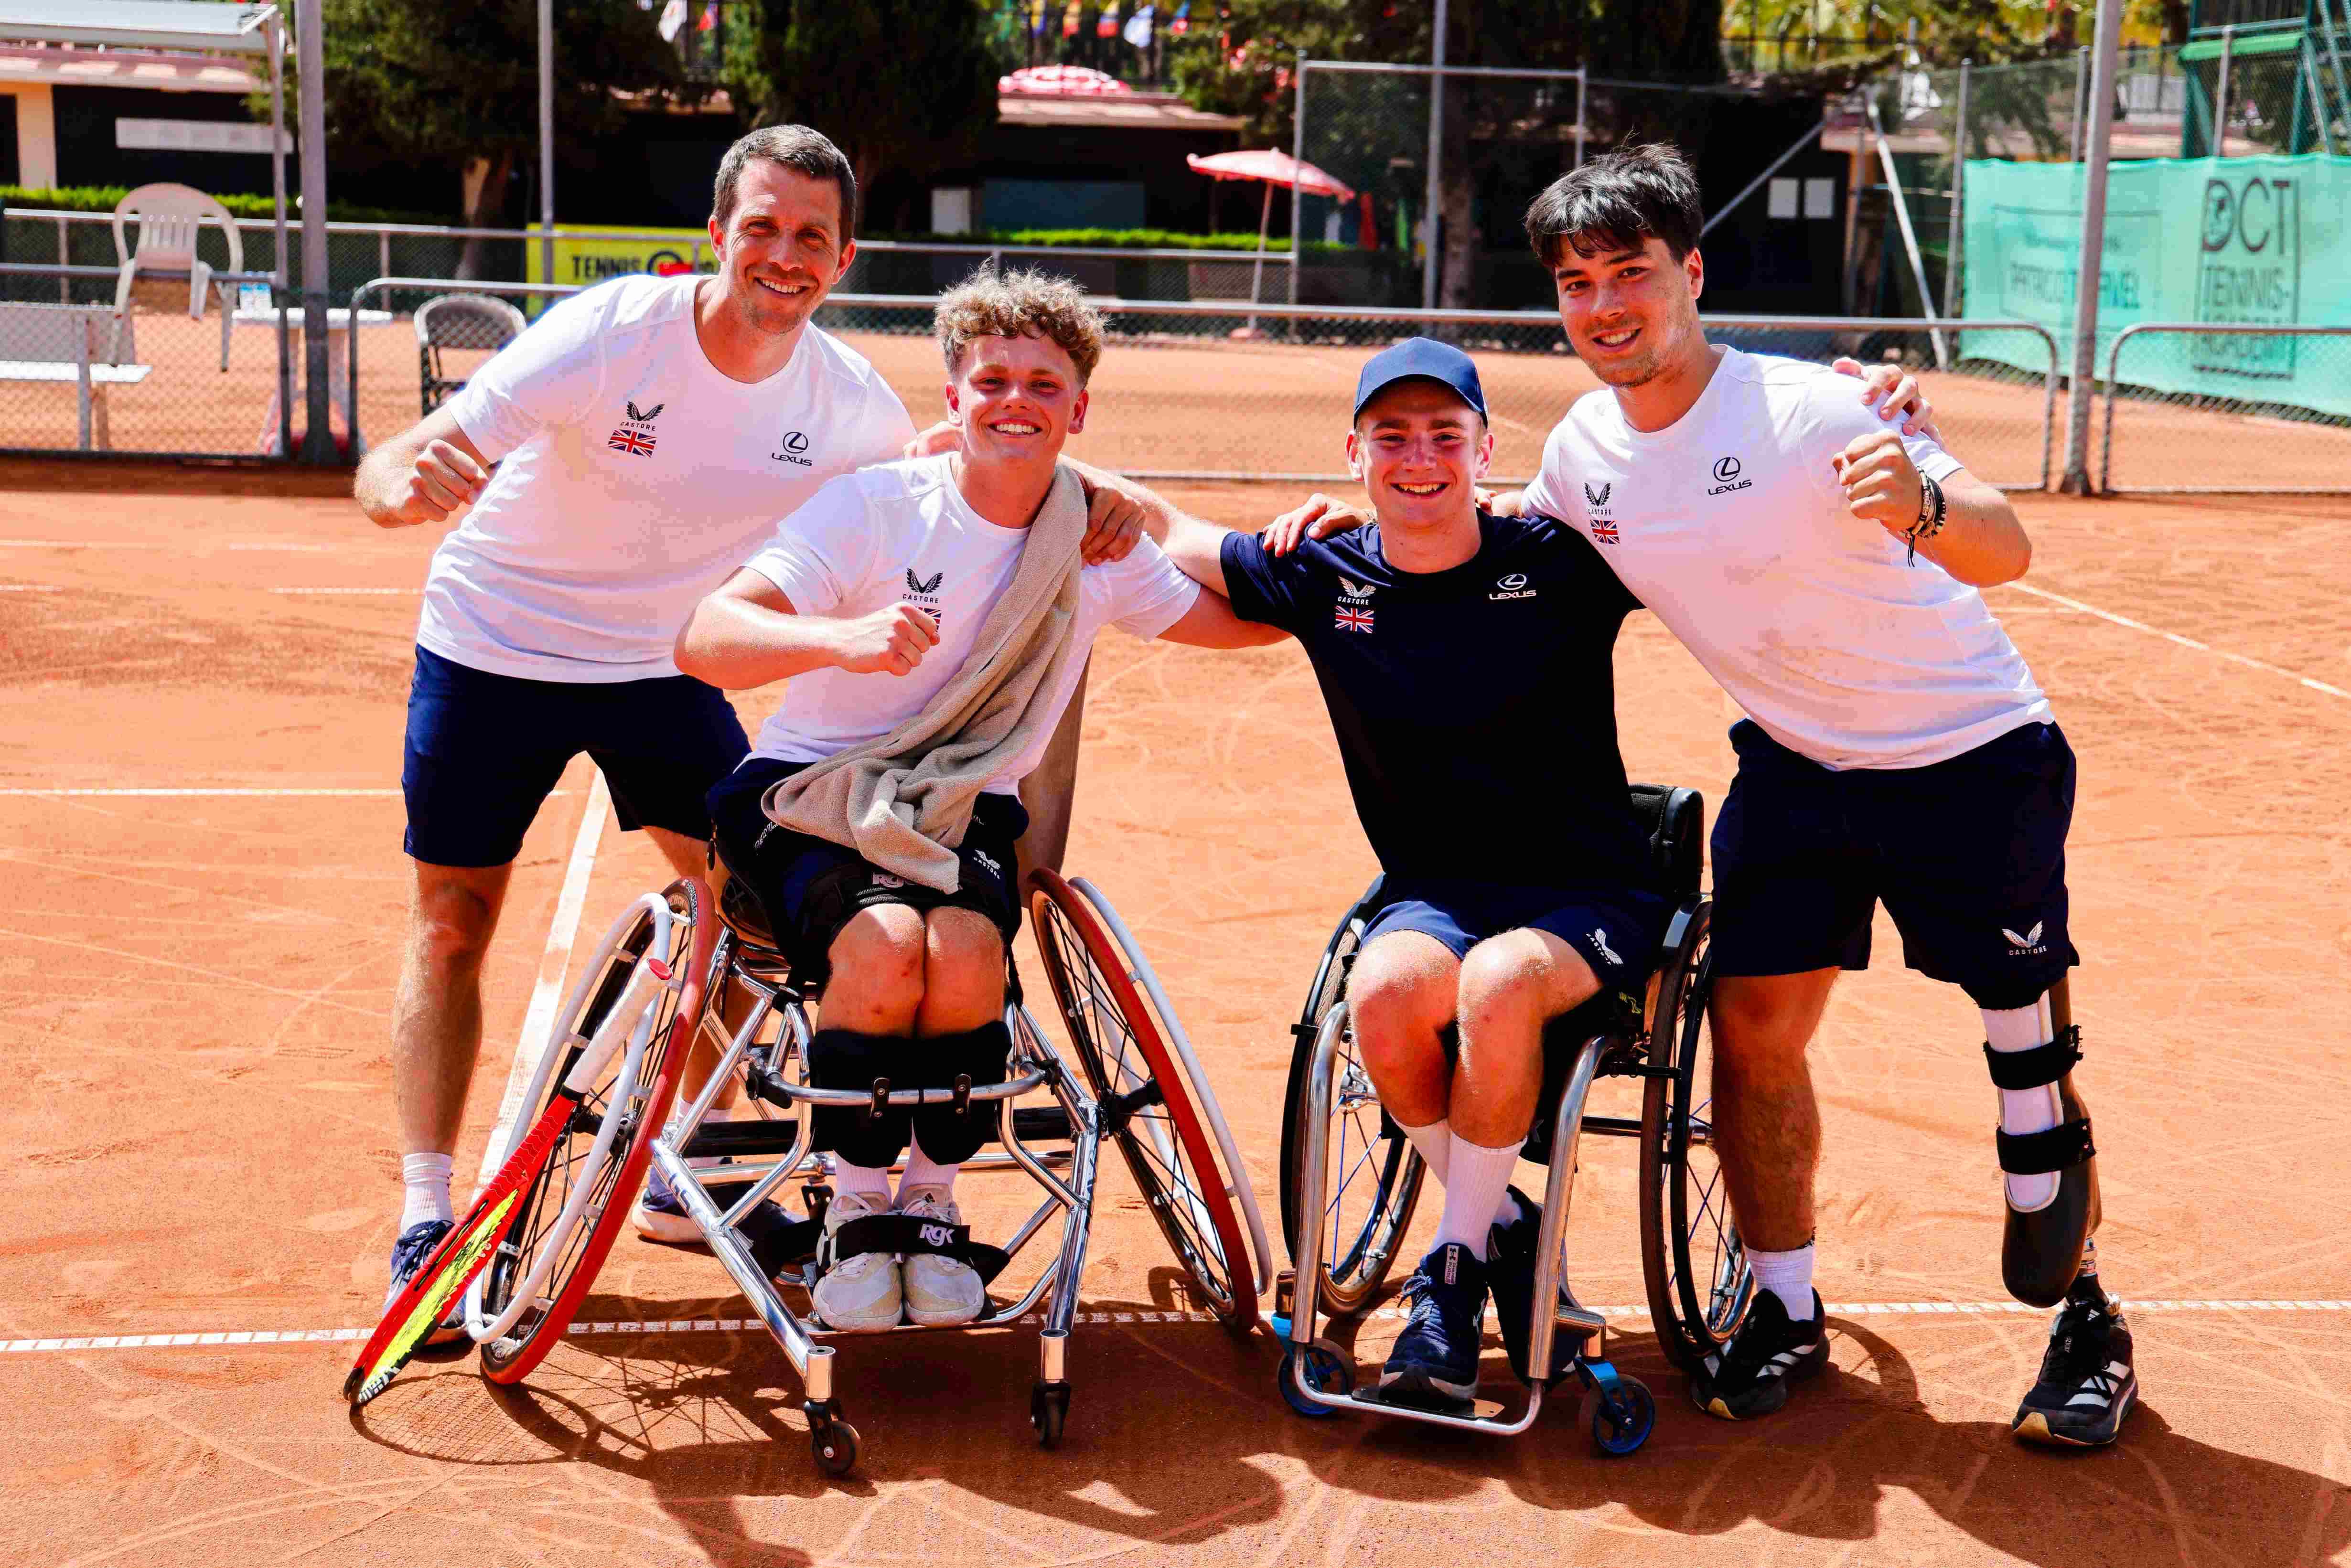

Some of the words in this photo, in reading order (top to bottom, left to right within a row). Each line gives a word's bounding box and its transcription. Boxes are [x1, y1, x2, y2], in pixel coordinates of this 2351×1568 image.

[620, 422, 656, 431] CASTORE
[772, 452, 813, 466] LEXUS
[1708, 479, 1752, 495] LEXUS
[902, 594, 939, 604] CASTORE
[1489, 590, 1537, 600] LEXUS
[1338, 596, 1369, 605] CASTORE
[2008, 945, 2048, 956] CASTORE
